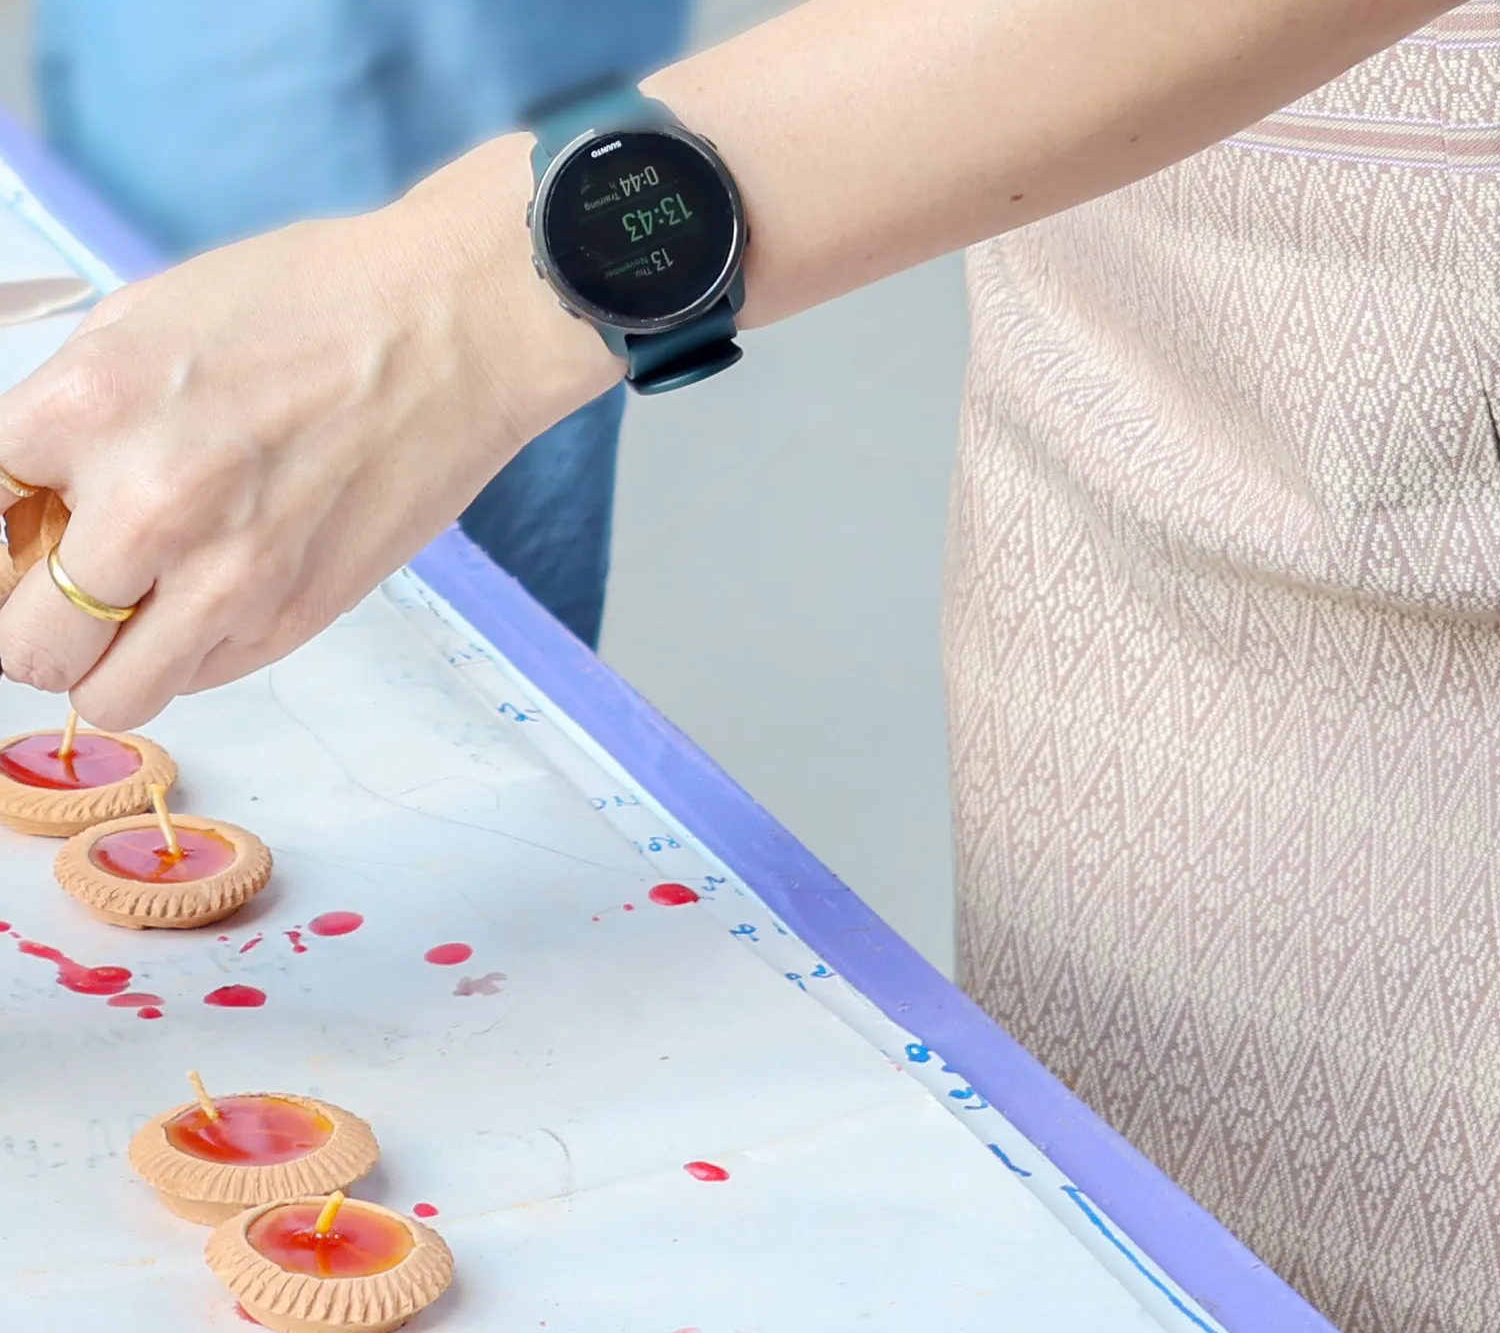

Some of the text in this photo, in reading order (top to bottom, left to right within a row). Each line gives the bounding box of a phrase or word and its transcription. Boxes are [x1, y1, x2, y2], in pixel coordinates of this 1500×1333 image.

[591, 140, 622, 158] SUUNTO
[583, 165, 660, 212] 0:44 Training
[621, 192, 694, 243] 13:43
[650, 247, 674, 273] 13
